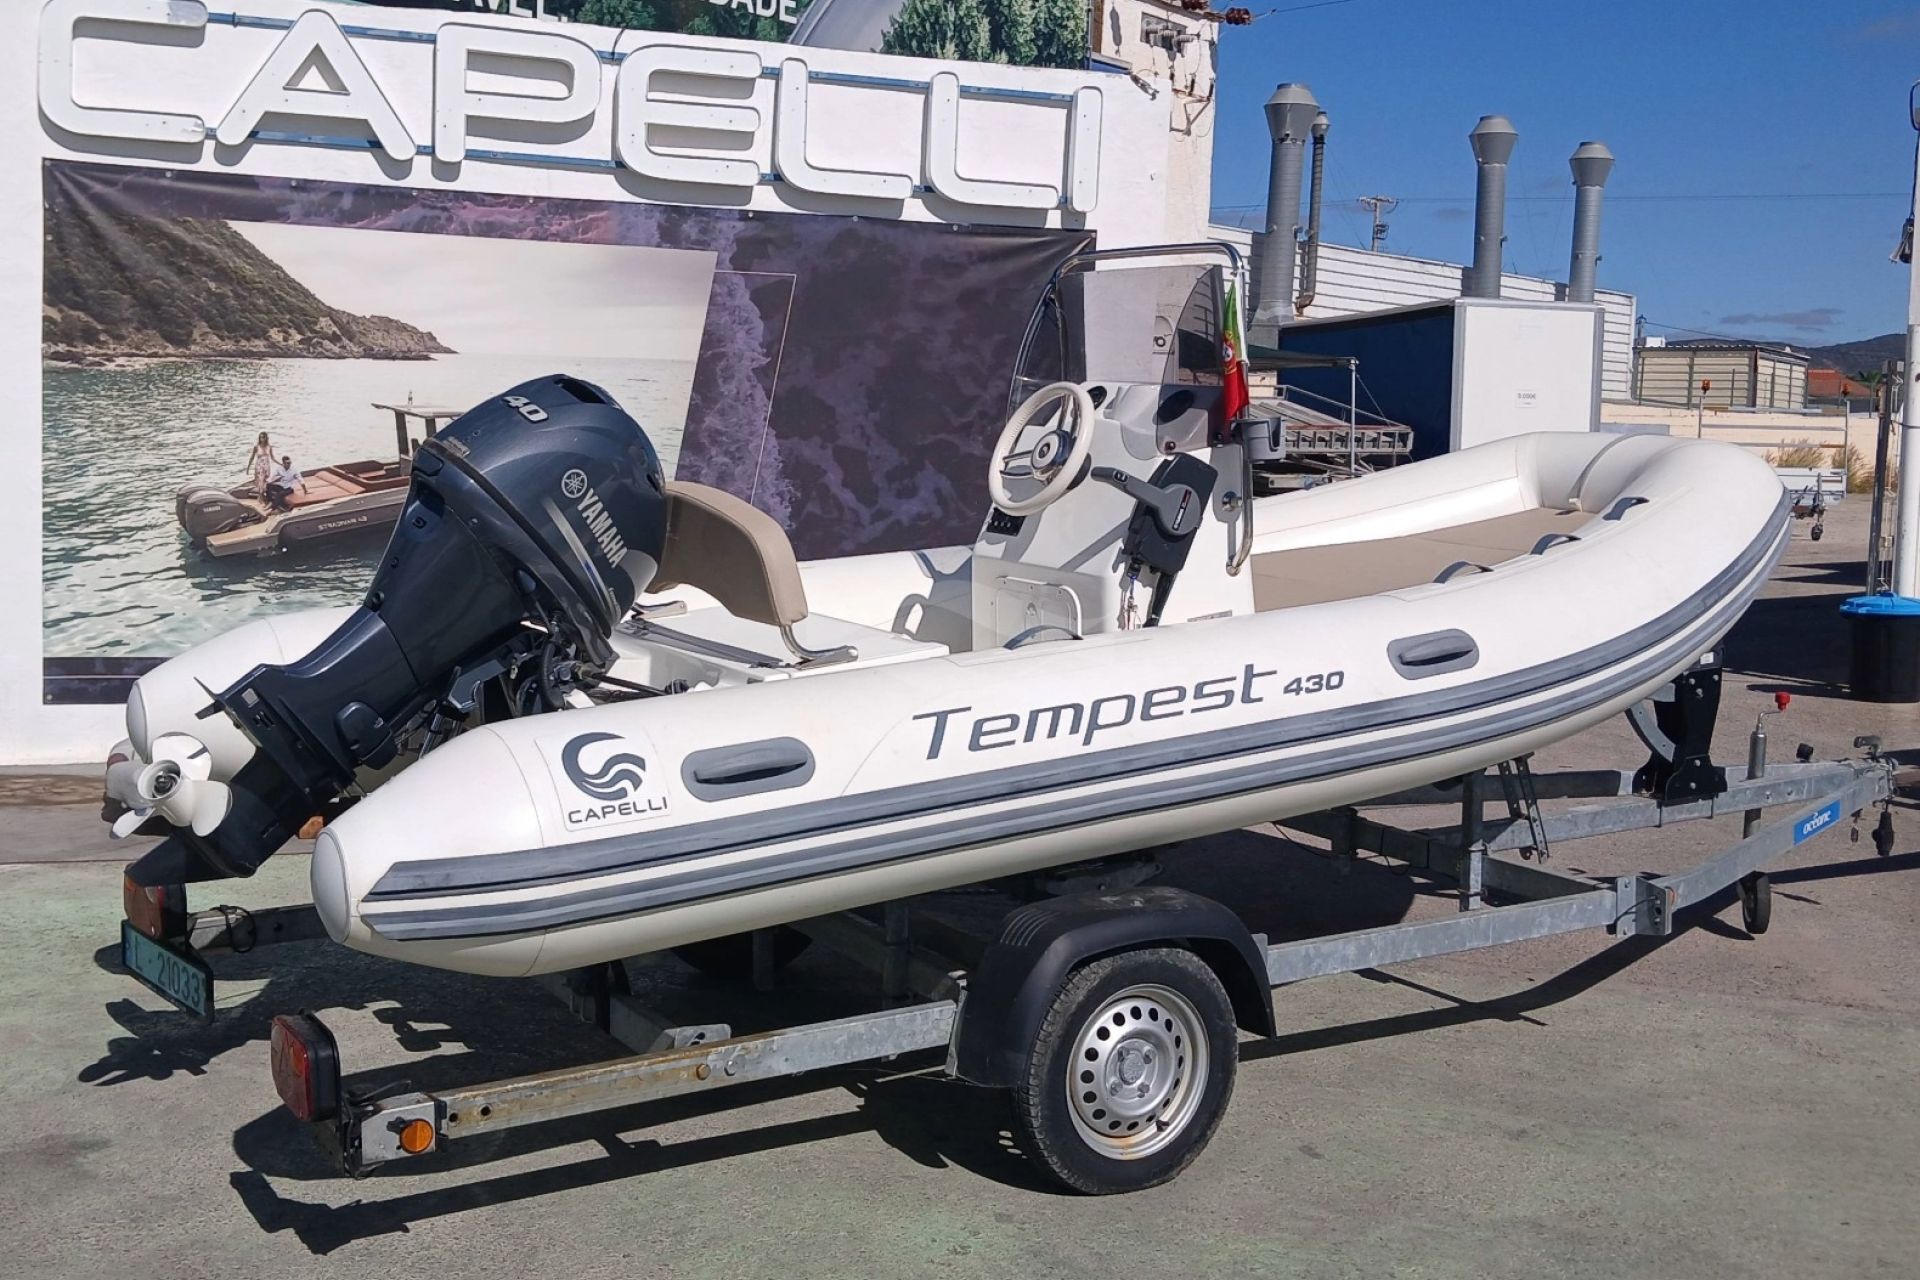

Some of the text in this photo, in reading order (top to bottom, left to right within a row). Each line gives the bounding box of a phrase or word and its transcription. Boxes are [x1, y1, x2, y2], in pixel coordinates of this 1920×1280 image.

[38, 0, 1102, 213] CAPELLI
[503, 396, 549, 423] 40
[577, 488, 628, 568] YAMAHA
[912, 664, 1345, 760] Tempest 430
[568, 796, 668, 824] CAPELLI
